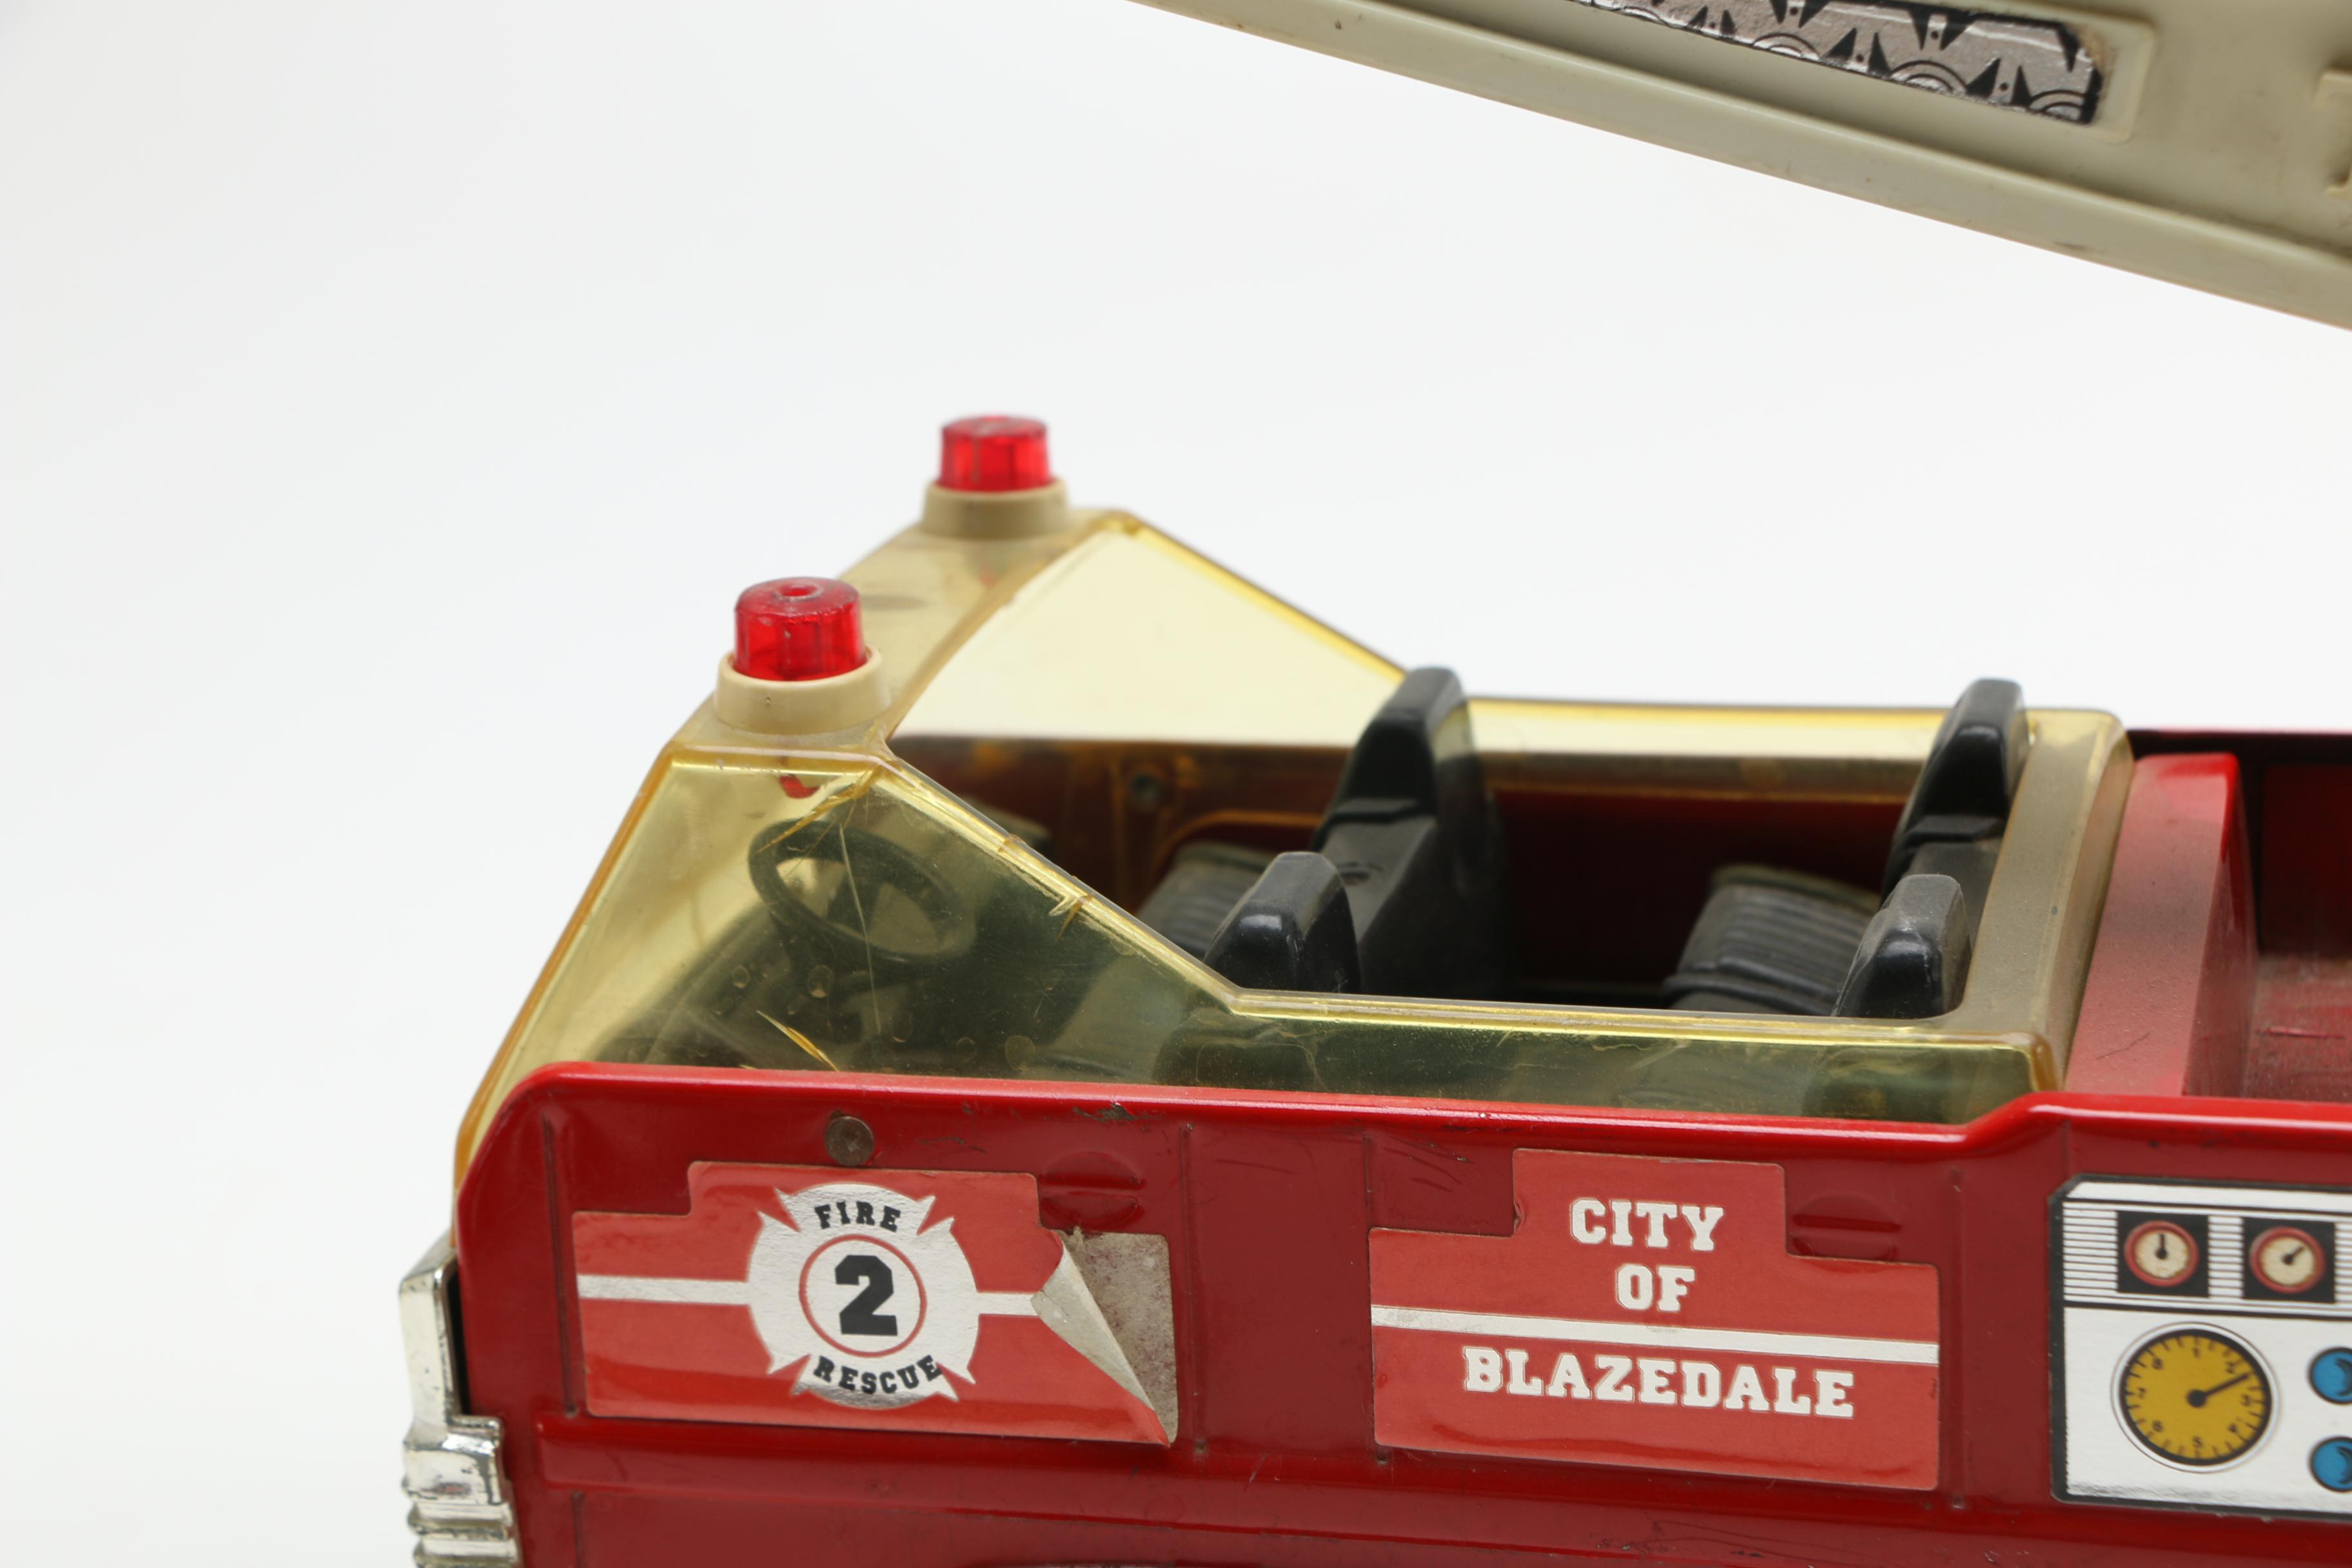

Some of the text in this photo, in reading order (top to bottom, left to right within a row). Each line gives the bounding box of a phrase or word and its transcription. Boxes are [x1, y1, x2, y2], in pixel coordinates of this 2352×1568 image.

[814, 1200, 901, 1233] FIRE
[1571, 1199, 1725, 1252] CITY
[834, 1254, 898, 1337] 2
[1614, 1263, 1696, 1313] OF
[813, 1355, 943, 1395] RESCUE
[1462, 1345, 1854, 1418] BLAZEDALE
